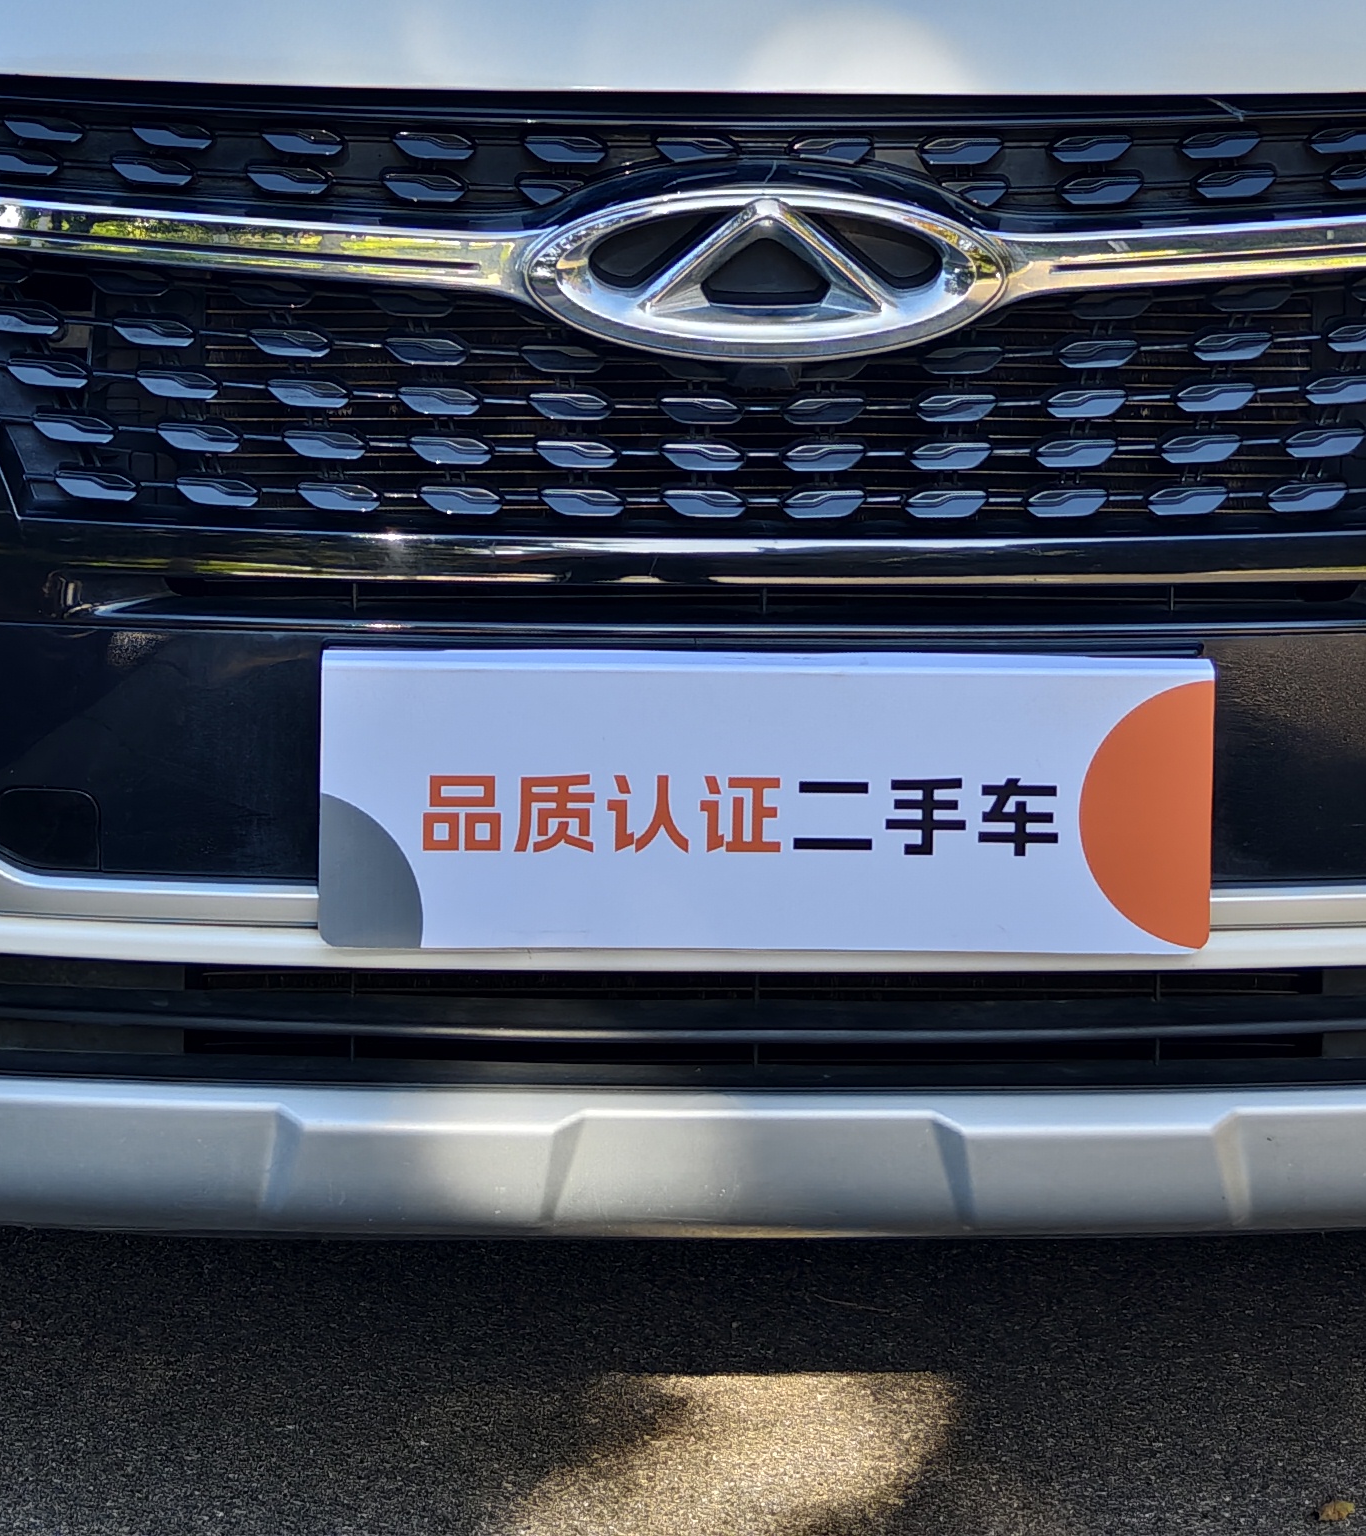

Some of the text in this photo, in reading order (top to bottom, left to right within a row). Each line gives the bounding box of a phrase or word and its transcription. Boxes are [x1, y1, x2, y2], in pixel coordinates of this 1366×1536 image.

[421, 773, 1060, 857] 品质认证二手车
